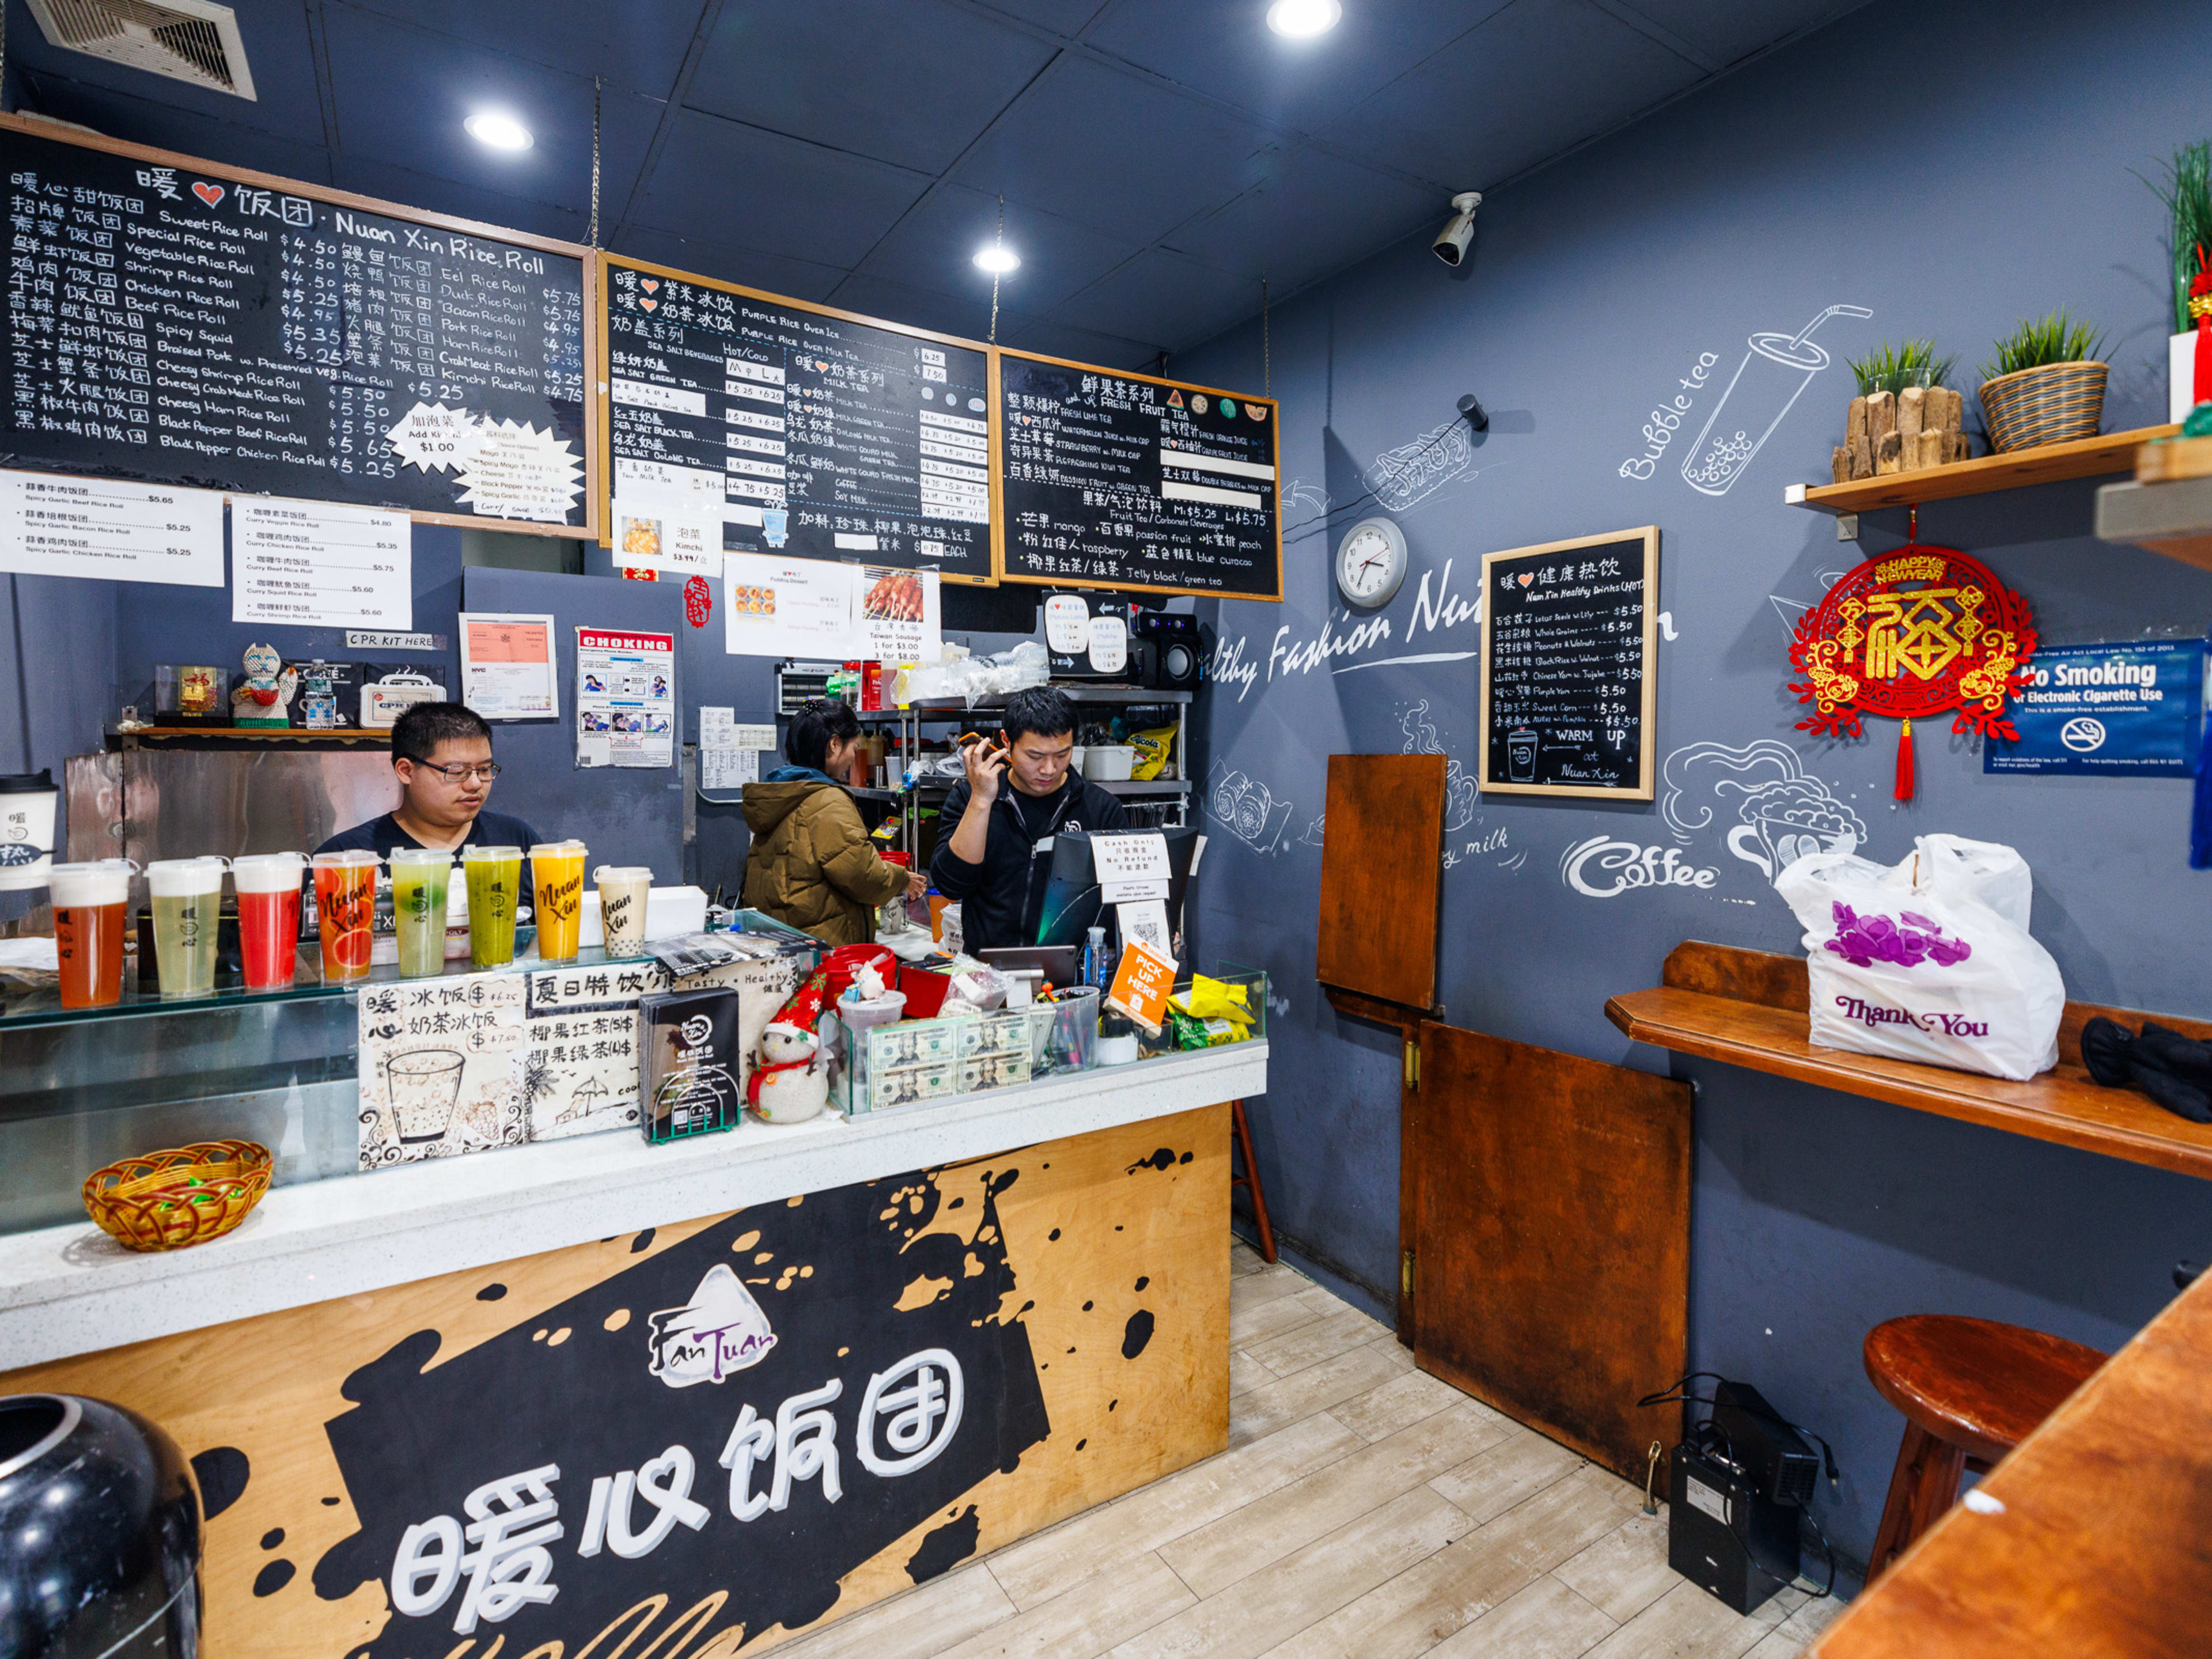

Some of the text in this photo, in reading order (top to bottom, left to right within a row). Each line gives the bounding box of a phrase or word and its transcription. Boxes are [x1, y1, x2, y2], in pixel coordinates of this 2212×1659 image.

[136, 168, 182, 201] 暖
[336, 212, 396, 244] Nuan
[404, 228, 444, 255] Xin
[450, 238, 499, 266] Rice
[505, 250, 544, 276] Roll
[160, 210, 210, 230] Sweet
[212, 221, 240, 237] Rice
[244, 228, 268, 241] Roll
[127, 224, 180, 243] Special
[184, 234, 215, 250] Rice
[220, 241, 245, 255] Roll
[125, 296, 160, 314] Beef
[164, 304, 195, 320] Rice
[198, 311, 225, 325] Roll
[615, 271, 639, 293] 暖
[779, 317, 800, 329] RICE
[823, 377, 847, 388] MILK
[1101, 397, 1189, 421] FRESH FRUIT TEA
[1618, 351, 1719, 481] Bubble tea
[421, 442, 454, 452] $1.00
[149, 495, 173, 505] $5.65
[675, 542, 703, 552] Kimchi
[1054, 521, 1085, 536] mango
[1136, 531, 1167, 541] passion
[1171, 533, 1191, 544] fruit
[1239, 541, 1262, 552] peach
[944, 545, 967, 558] EACH
[1082, 543, 1128, 559] raspberry
[1197, 551, 1215, 563] blue
[1220, 556, 1252, 566] curacao
[1889, 556, 1937, 570] HAPPY
[1127, 567, 1150, 584] Jelly
[1154, 570, 1177, 582] black
[1209, 577, 1222, 586] tea
[1500, 572, 1516, 590] 暖
[1545, 589, 1558, 600] Xin
[1560, 586, 1591, 599] Healthy
[1593, 584, 1620, 594] Drinks
[1601, 621, 1633, 632] $5.50
[350, 634, 433, 646] CPR KIT HERE
[583, 637, 667, 650] CHOKING
[896, 634, 922, 642] Sausage
[1268, 609, 1391, 683] Fashion
[2054, 662, 2157, 687] Smoking
[2028, 690, 2081, 703] Electronic
[2083, 690, 2137, 703] Cigarette
[2139, 688, 2163, 701] Use
[1532, 703, 1556, 711] Sweet
[1560, 703, 1577, 711] Corn
[1555, 730, 1626, 750] WARM UP
[1584, 751, 1599, 762] at
[1561, 763, 1619, 779] Nuan Xin
[1466, 826, 1508, 855] milk
[1563, 835, 1721, 898] Coffee
[320, 882, 369, 919] Nuan
[539, 874, 582, 908] Nuan
[550, 900, 578, 925] Xin
[600, 894, 632, 921] Nuan
[331, 909, 365, 937] Xin
[607, 915, 628, 936] Xin
[1135, 953, 1163, 979] PICK
[1138, 968, 1155, 984] UP
[686, 979, 725, 988] Tasty
[1127, 975, 1158, 1002] HERE
[1835, 996, 1989, 1037] Thank You
